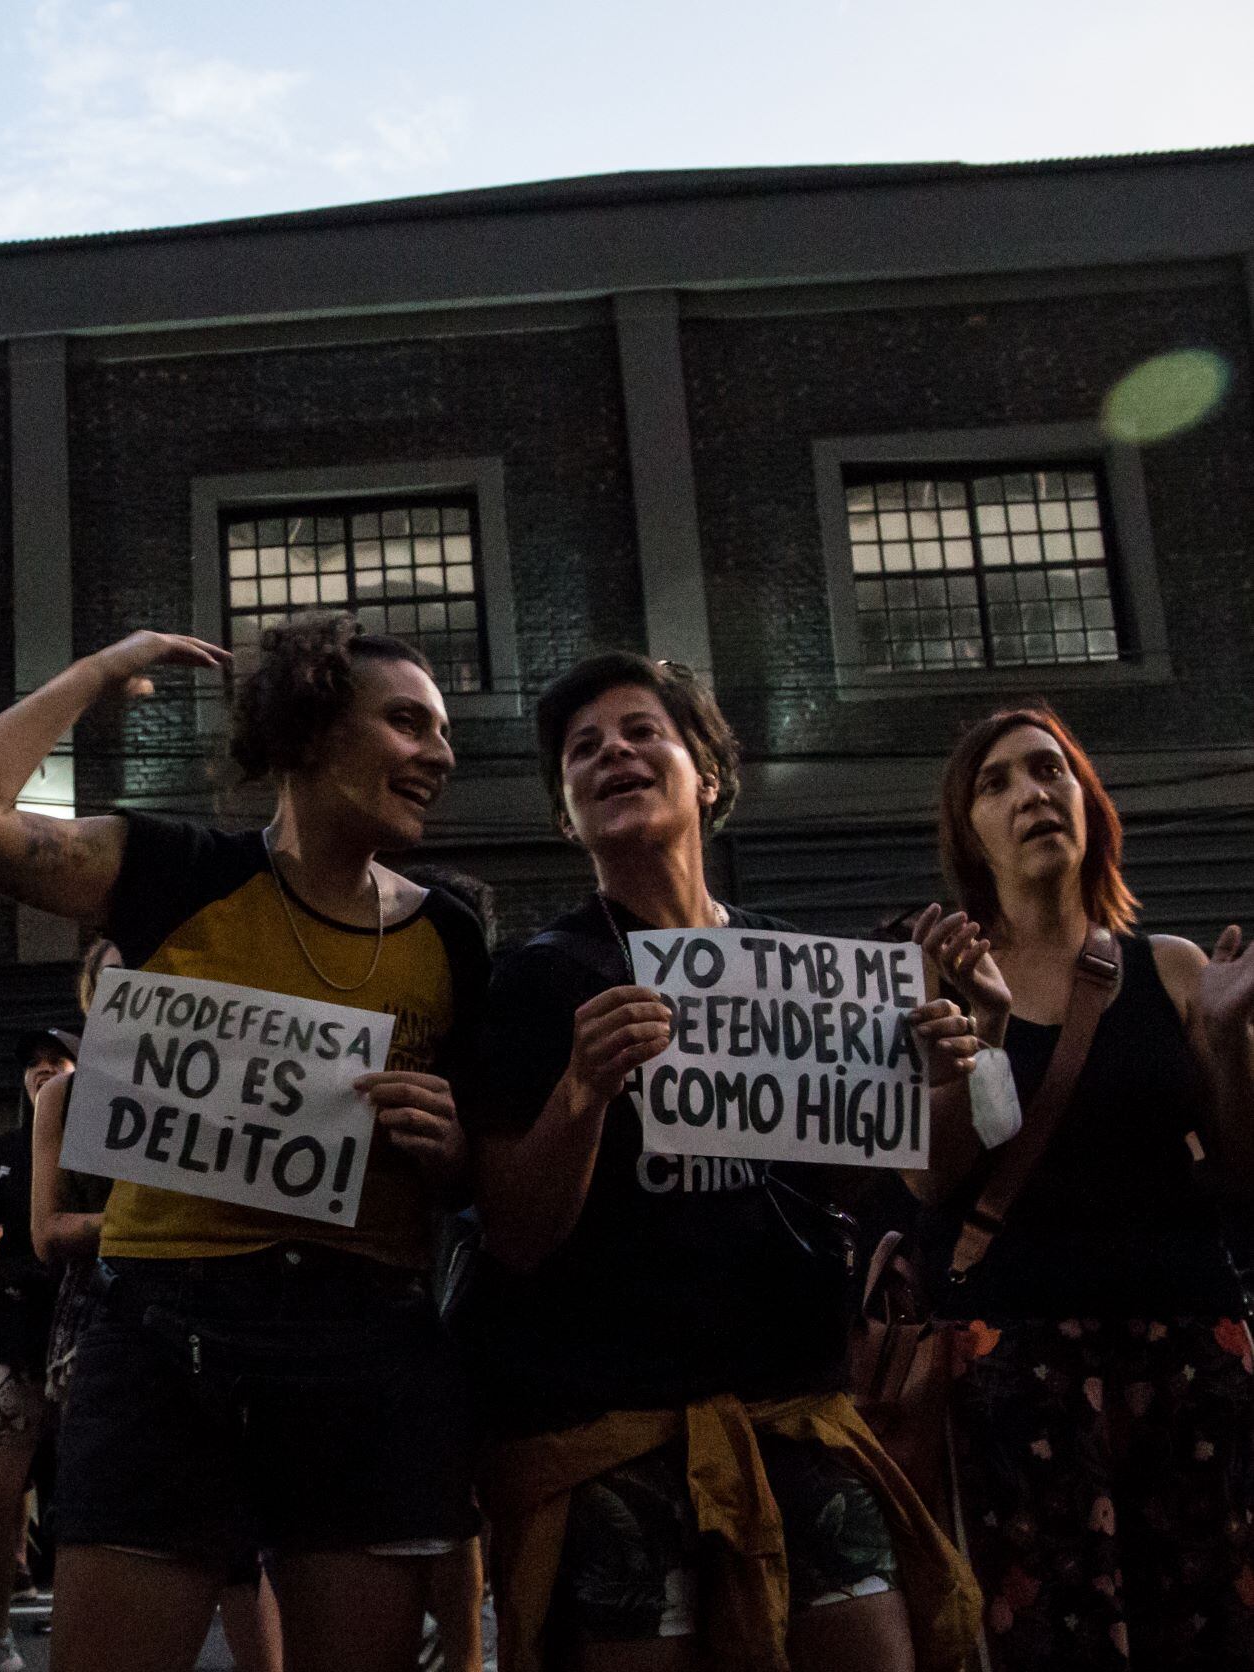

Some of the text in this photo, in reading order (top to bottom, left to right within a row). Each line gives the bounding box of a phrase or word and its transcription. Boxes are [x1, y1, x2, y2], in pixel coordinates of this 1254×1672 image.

[643, 937, 918, 1007] YO TMB ME
[101, 981, 373, 1068] AUTODEFENSA
[133, 1032, 306, 1117] NO ES
[650, 1064, 784, 1134] COMO
